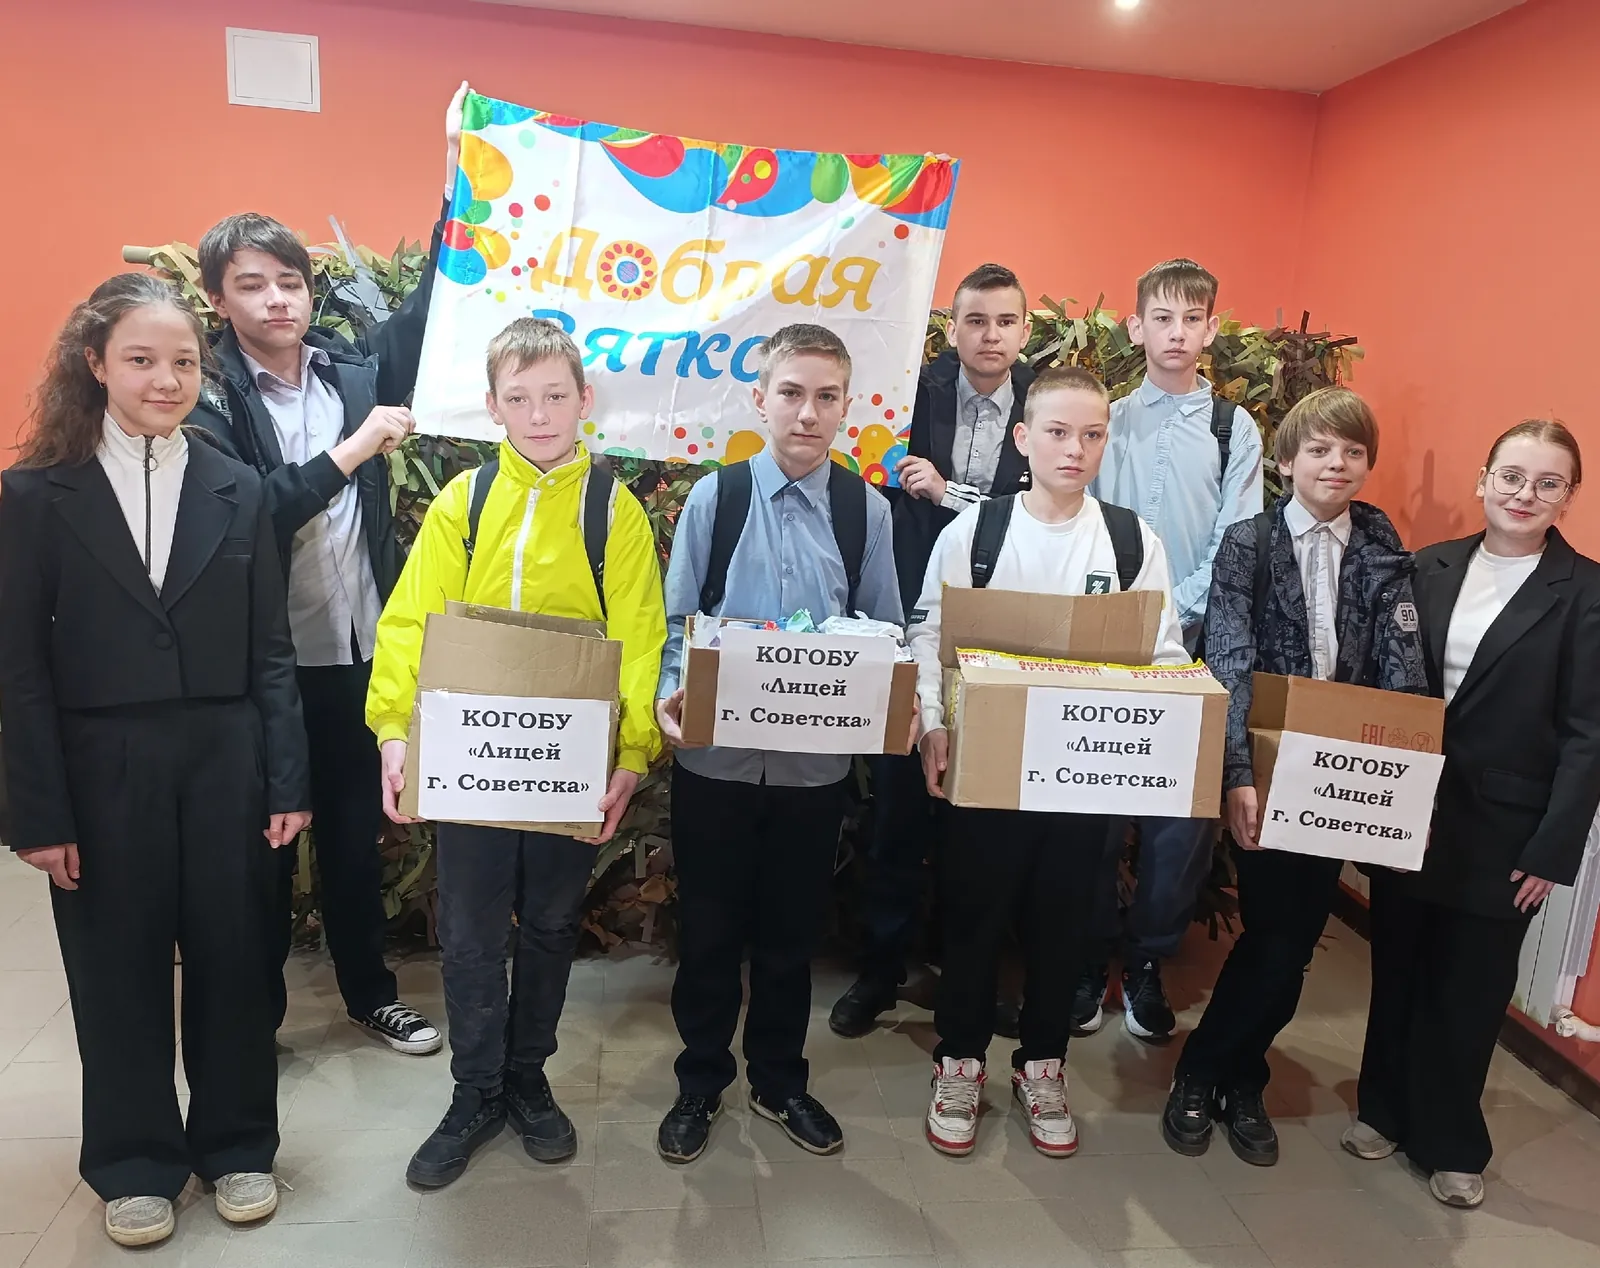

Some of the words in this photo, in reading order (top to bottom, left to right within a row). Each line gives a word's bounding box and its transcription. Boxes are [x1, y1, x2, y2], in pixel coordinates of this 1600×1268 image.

[530, 227, 882, 322] Добрая
[756, 645, 860, 667] КОГОБУ
[761, 678, 847, 697] «Лицей
[461, 709, 573, 730] КОГОБУ
[721, 708, 740, 721] г.
[750, 707, 871, 727] Советска»
[1061, 704, 1166, 725] КОГОБУ
[468, 741, 562, 761] «Лицей
[1066, 737, 1152, 755] «Лицей
[1313, 751, 1410, 779] КОГОБУ
[427, 776, 448, 789] г.
[457, 774, 589, 793] Советска»
[1027, 770, 1046, 783] г.
[1055, 767, 1177, 788] Советска»
[1313, 783, 1394, 807] «Лицей
[1271, 809, 1290, 823] г.
[1299, 811, 1412, 840] Советска»
